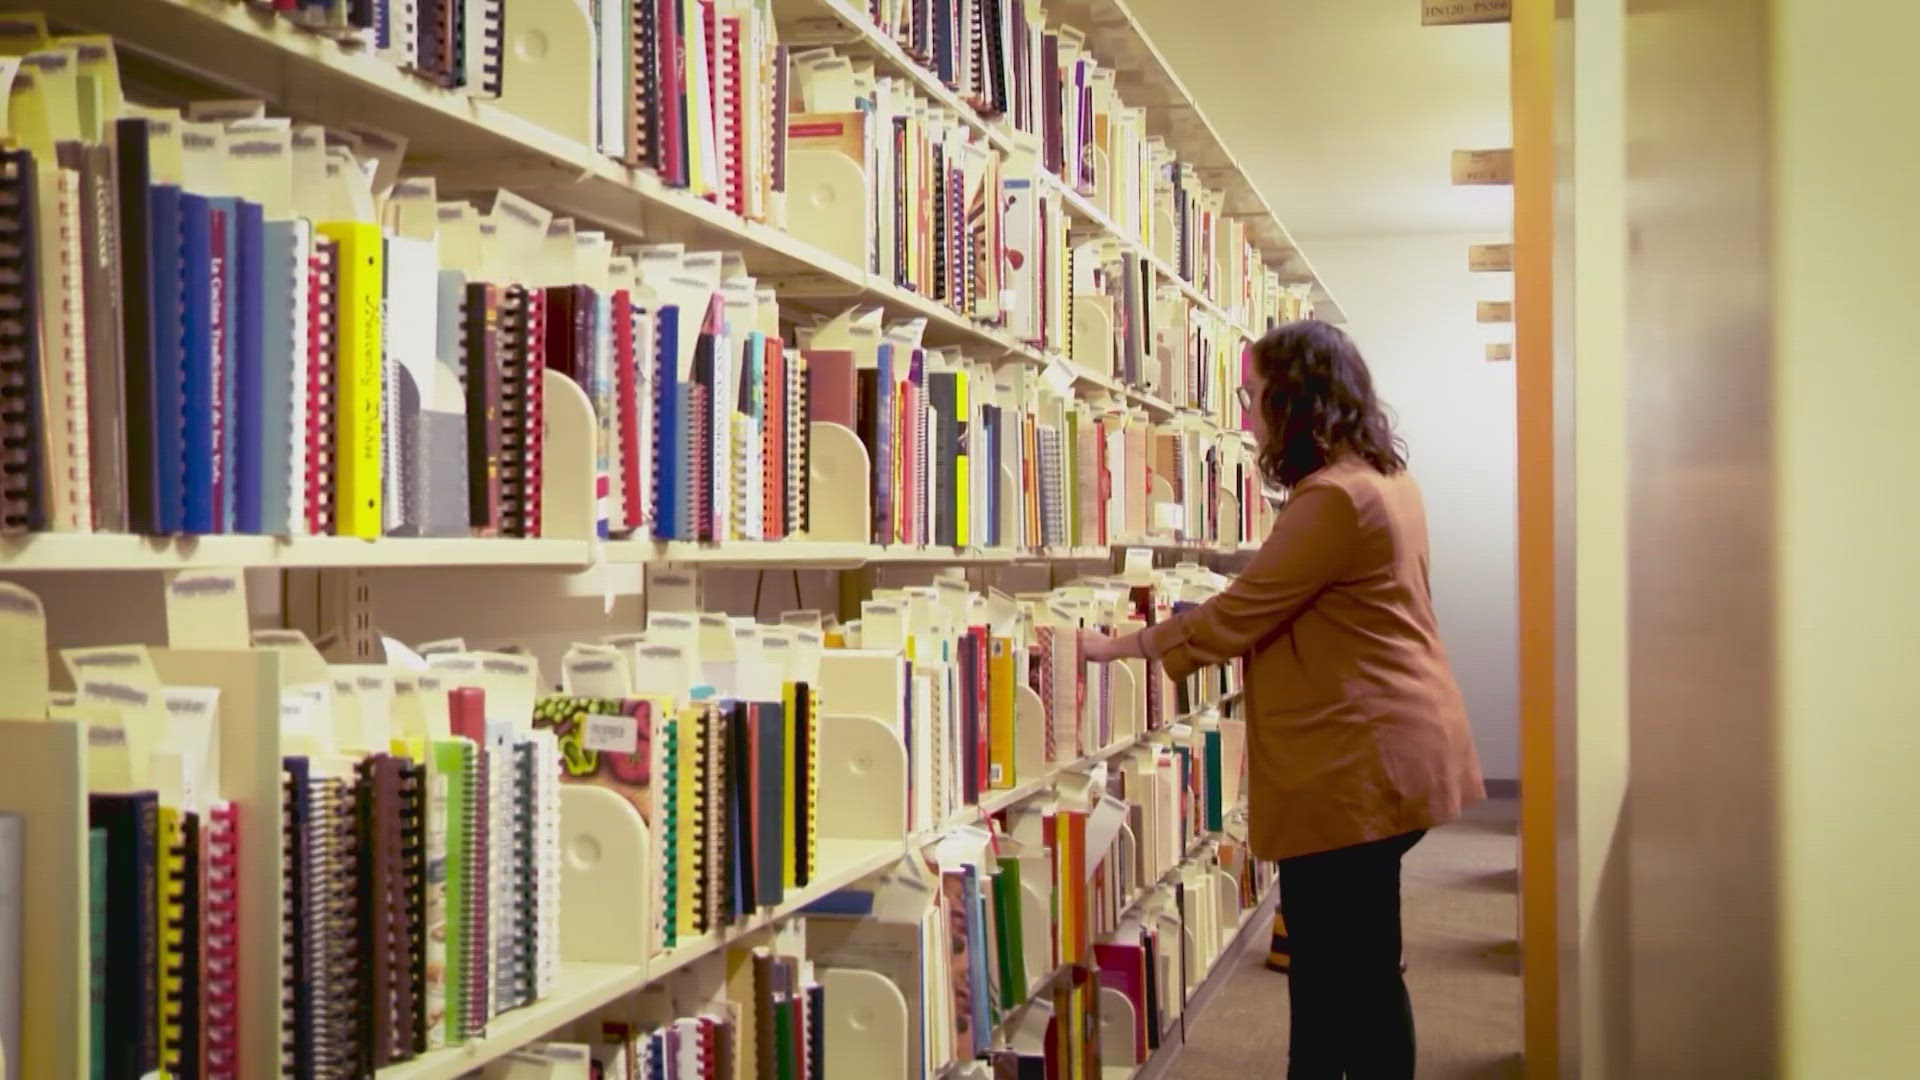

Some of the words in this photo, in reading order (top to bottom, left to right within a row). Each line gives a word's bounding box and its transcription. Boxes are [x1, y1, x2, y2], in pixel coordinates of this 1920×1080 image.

[210, 256, 222, 274] La
[210, 277, 223, 325] Cocina
[210, 328, 223, 406] Tradicional
[211, 409, 223, 426] de
